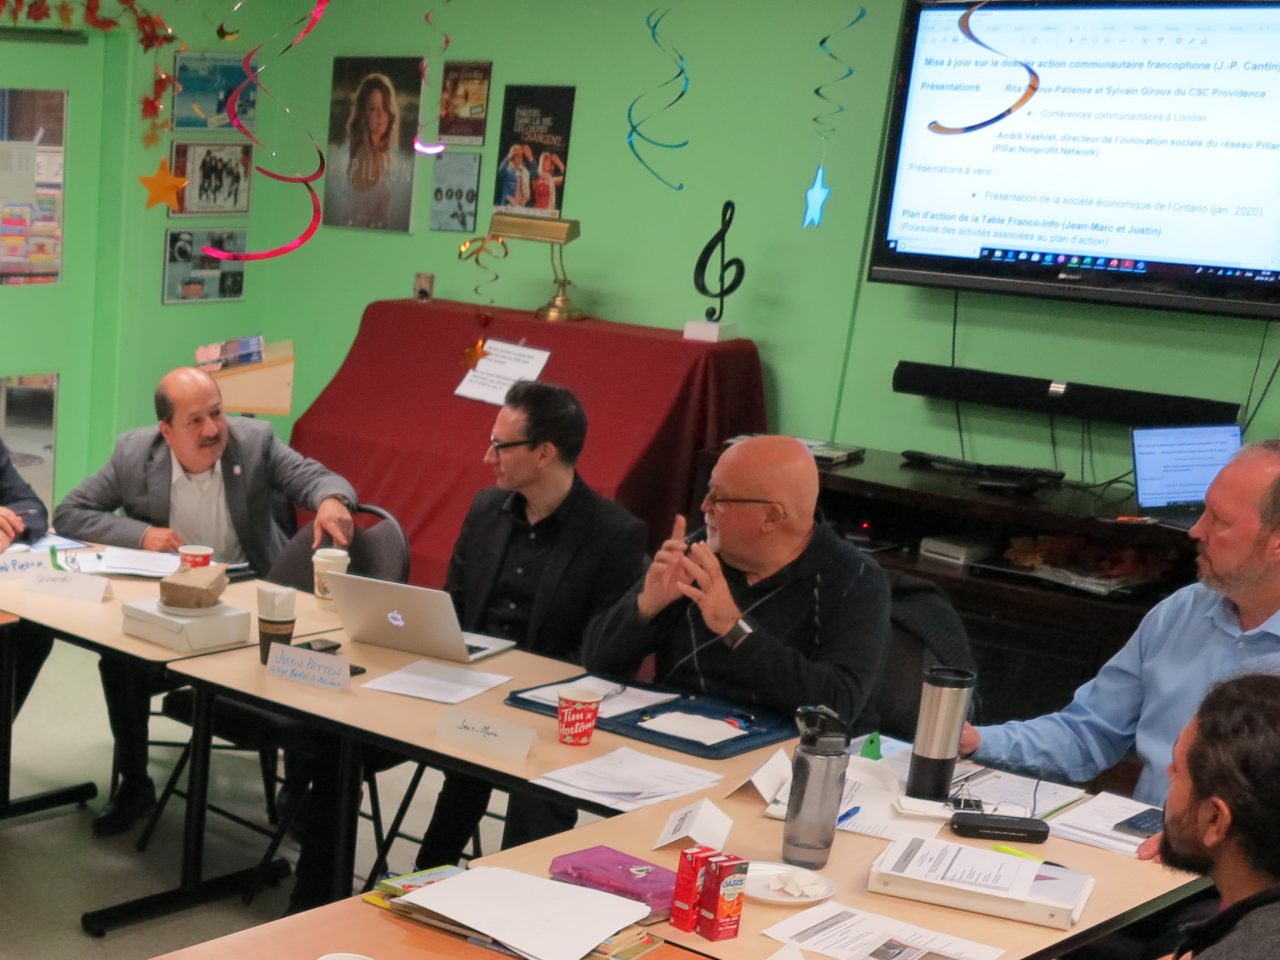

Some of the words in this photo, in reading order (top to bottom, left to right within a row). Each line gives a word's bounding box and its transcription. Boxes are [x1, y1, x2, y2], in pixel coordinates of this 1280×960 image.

[924, 57, 945, 67] Mise
[953, 58, 972, 69] jour
[973, 60, 989, 68] sur
[990, 59, 1000, 68] le
[1037, 59, 1067, 69] action
[1068, 60, 1144, 71] communautaire
[1146, 60, 1212, 73] francophone
[920, 82, 981, 92] Présentations
[1093, 86, 1104, 95] et
[1105, 86, 1139, 97] Sylvain
[1140, 87, 1172, 97] Giroux
[1173, 87, 1186, 97] du
[1188, 88, 1210, 98] CSC
[1211, 88, 1267, 99] Providence
[1094, 112, 1164, 122] communautaires
[1173, 113, 1207, 123] London
[1060, 133, 1100, 144] directeur
[1101, 135, 1113, 145] de
[1169, 138, 1203, 148] sociale
[1018, 145, 1058, 156] Nonprofit
[908, 163, 963, 175] Présentations
[984, 191, 1038, 203] Présentation
[902, 209, 921, 219] Plan
[958, 213, 970, 222] de
[971, 213, 980, 223] la
[982, 215, 1006, 225] Table
[1115, 225, 1126, 234] et
[562, 708, 585, 723] Tim
[721, 878, 744, 888] OASIS
